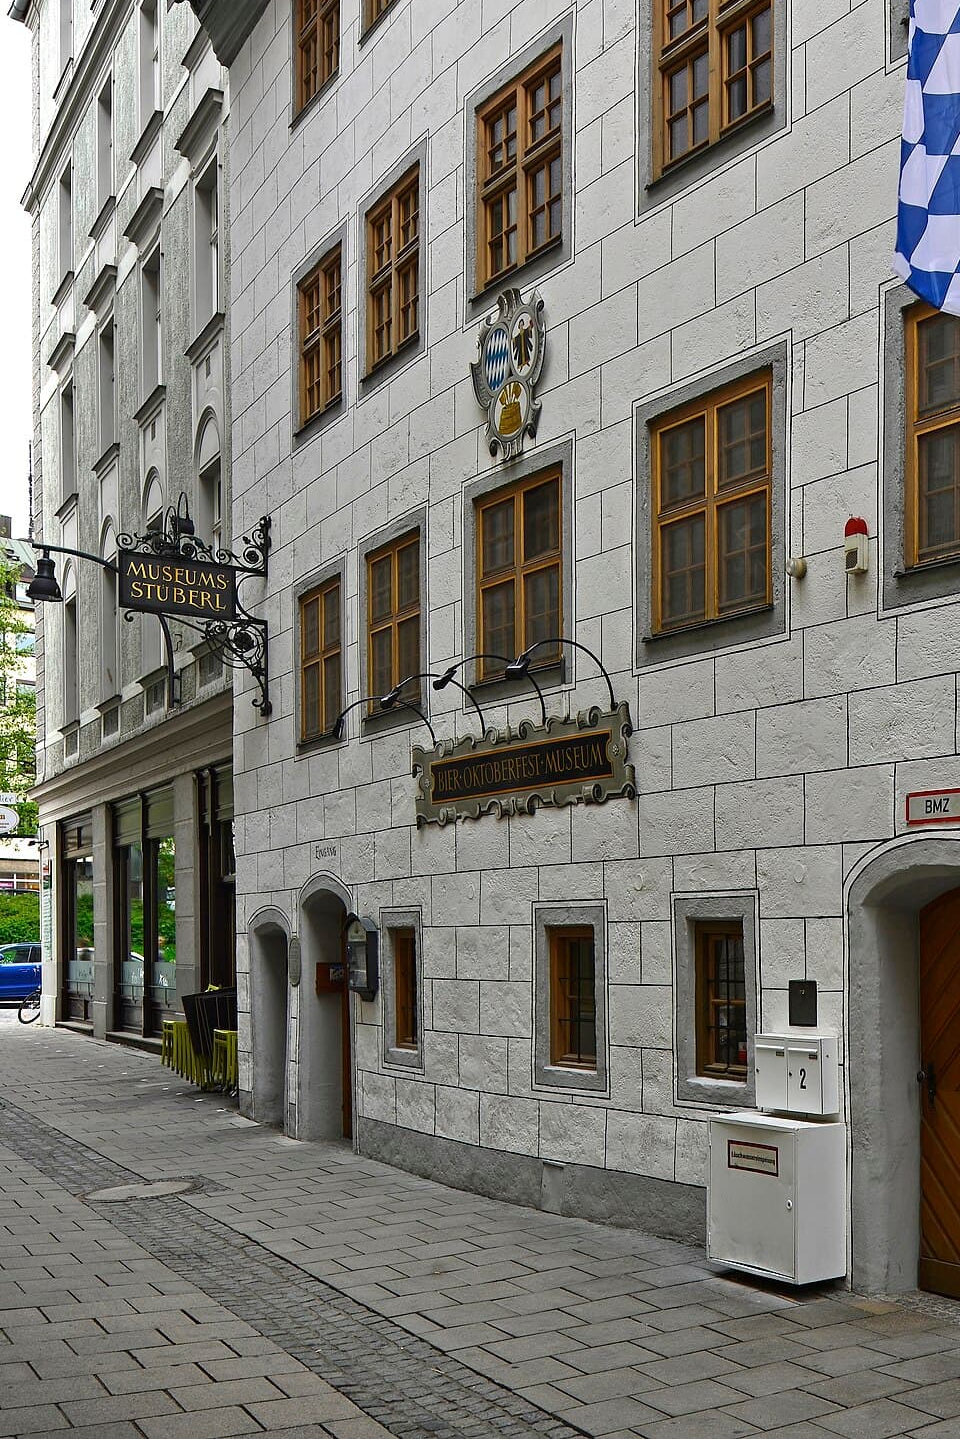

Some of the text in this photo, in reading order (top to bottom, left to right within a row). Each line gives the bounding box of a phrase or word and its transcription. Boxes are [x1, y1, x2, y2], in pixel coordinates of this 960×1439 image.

[130, 581, 227, 612] STÜBERL
[545, 742, 604, 773] MUSEUM
[925, 798, 950, 814] BMZ
[799, 1068, 807, 1090] 2
